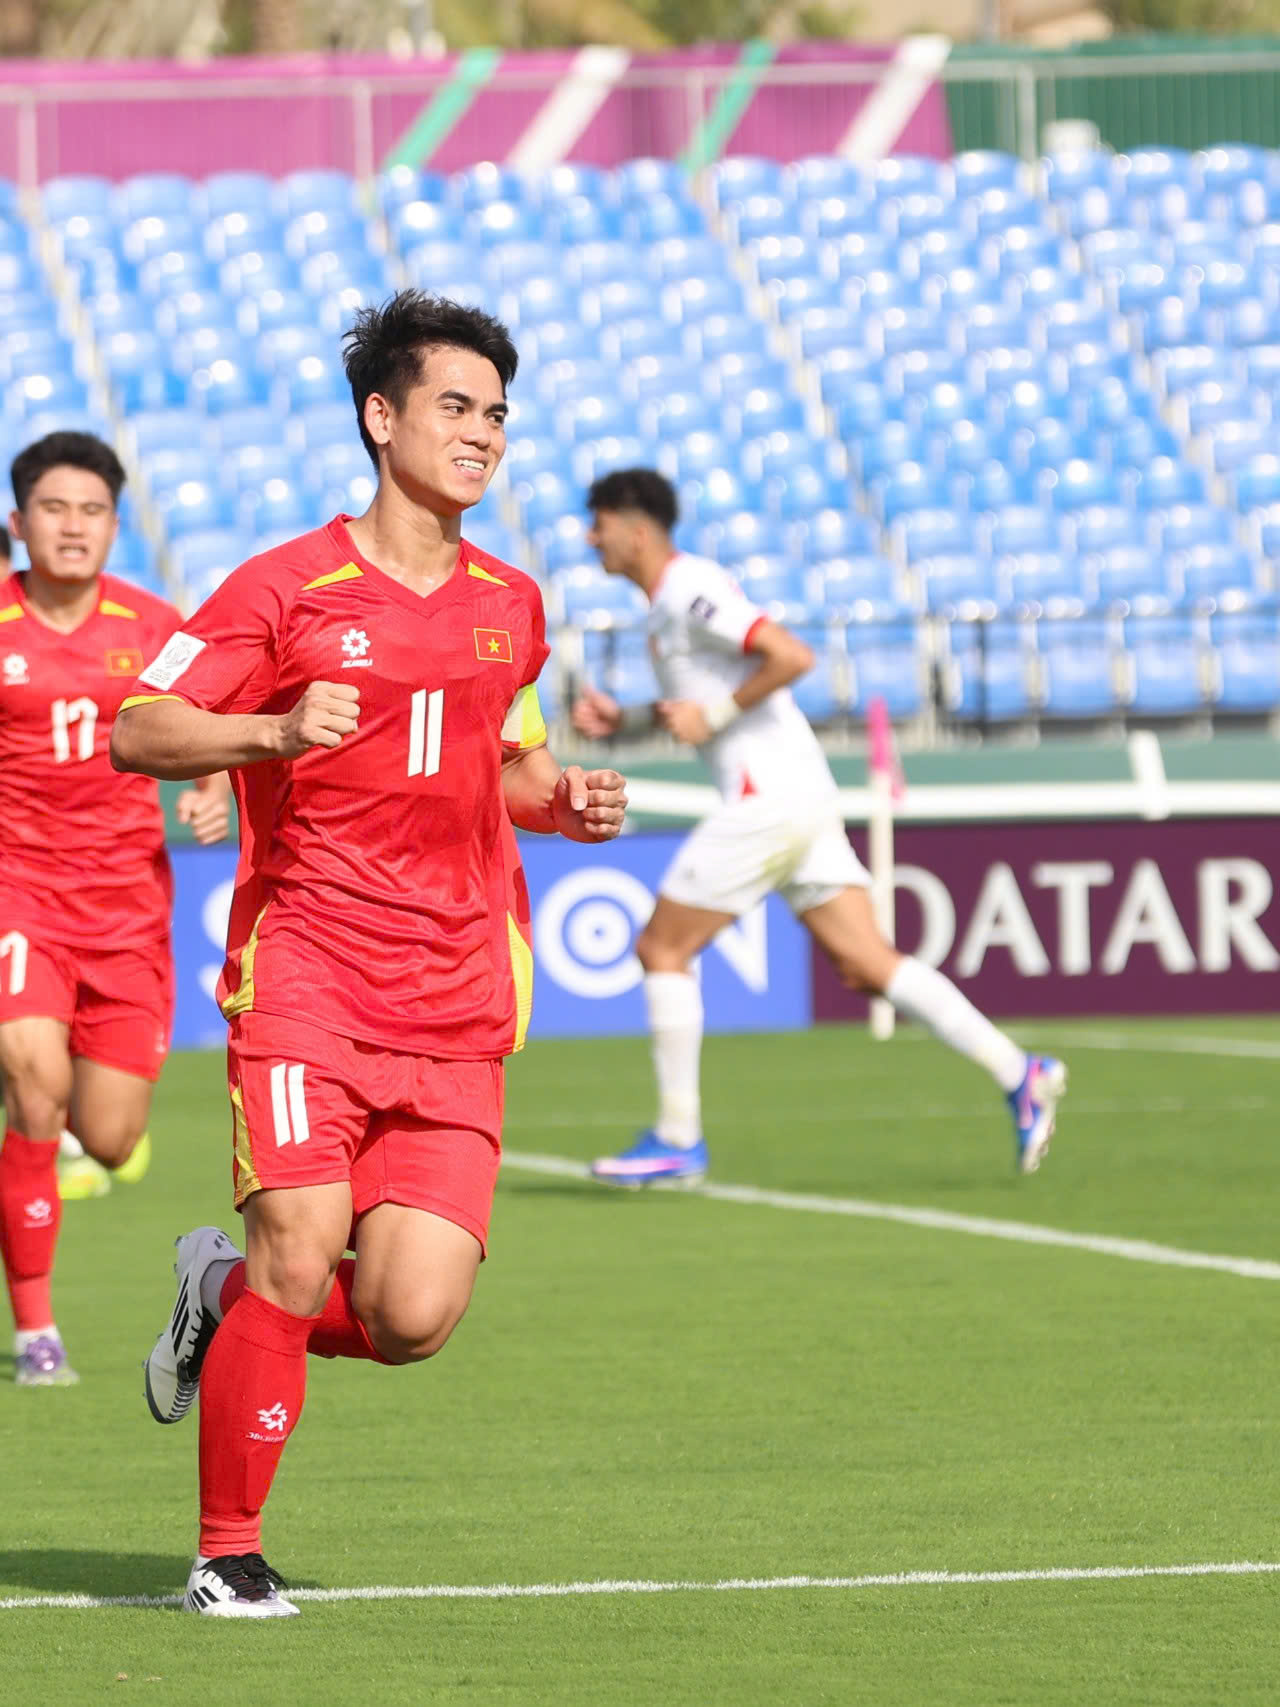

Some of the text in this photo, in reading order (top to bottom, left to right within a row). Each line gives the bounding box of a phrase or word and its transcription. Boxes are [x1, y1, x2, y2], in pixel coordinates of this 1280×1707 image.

[51, 696, 99, 763] 17
[407, 688, 445, 778] 11
[270, 1063, 311, 1148] 11
